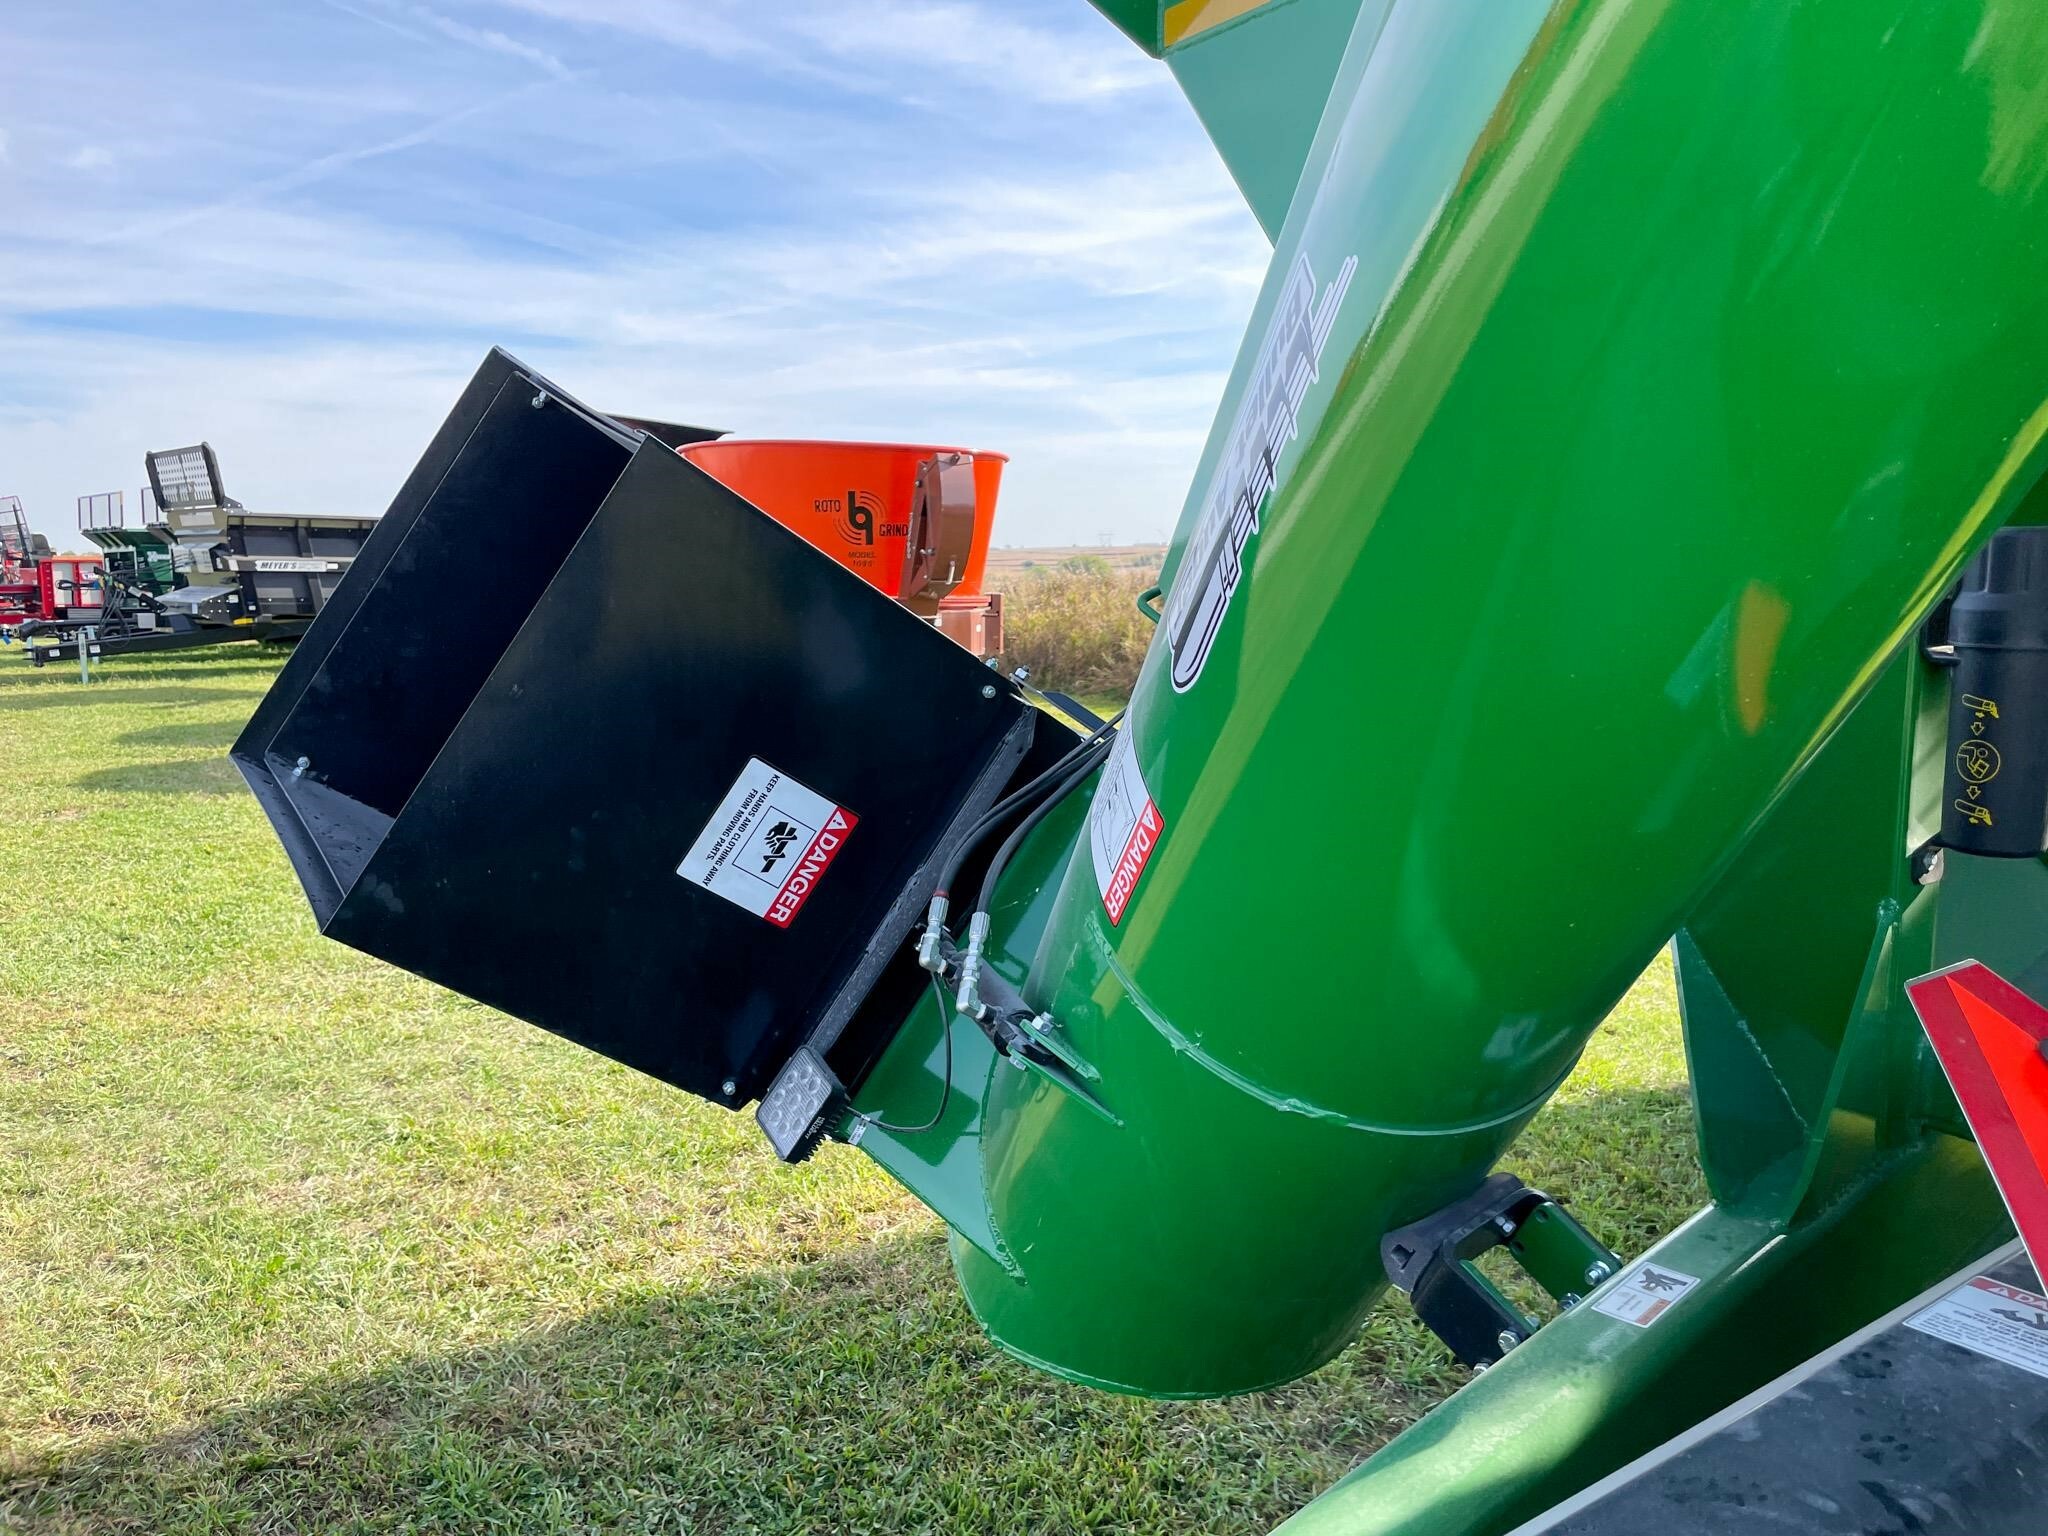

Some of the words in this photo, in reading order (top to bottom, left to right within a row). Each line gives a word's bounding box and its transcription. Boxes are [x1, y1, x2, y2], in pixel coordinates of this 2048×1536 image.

[1236, 274, 1304, 469] Bullet
[814, 499, 841, 512] ROTO
[879, 523, 909, 536] GRIND
[260, 561, 297, 570] MEYER'S
[848, 551, 876, 559] MODEL
[765, 774, 781, 793] KEEP
[741, 788, 759, 809] FROM
[751, 792, 768, 818] HANDS
[722, 809, 745, 838] MOVING
[738, 817, 752, 833] AND
[705, 837, 726, 860] PARTS.
[715, 832, 741, 867] CLOTHING
[702, 865, 719, 887] AWAY
[769, 832, 839, 922] DANGER
[1106, 826, 1151, 918] DANGER
